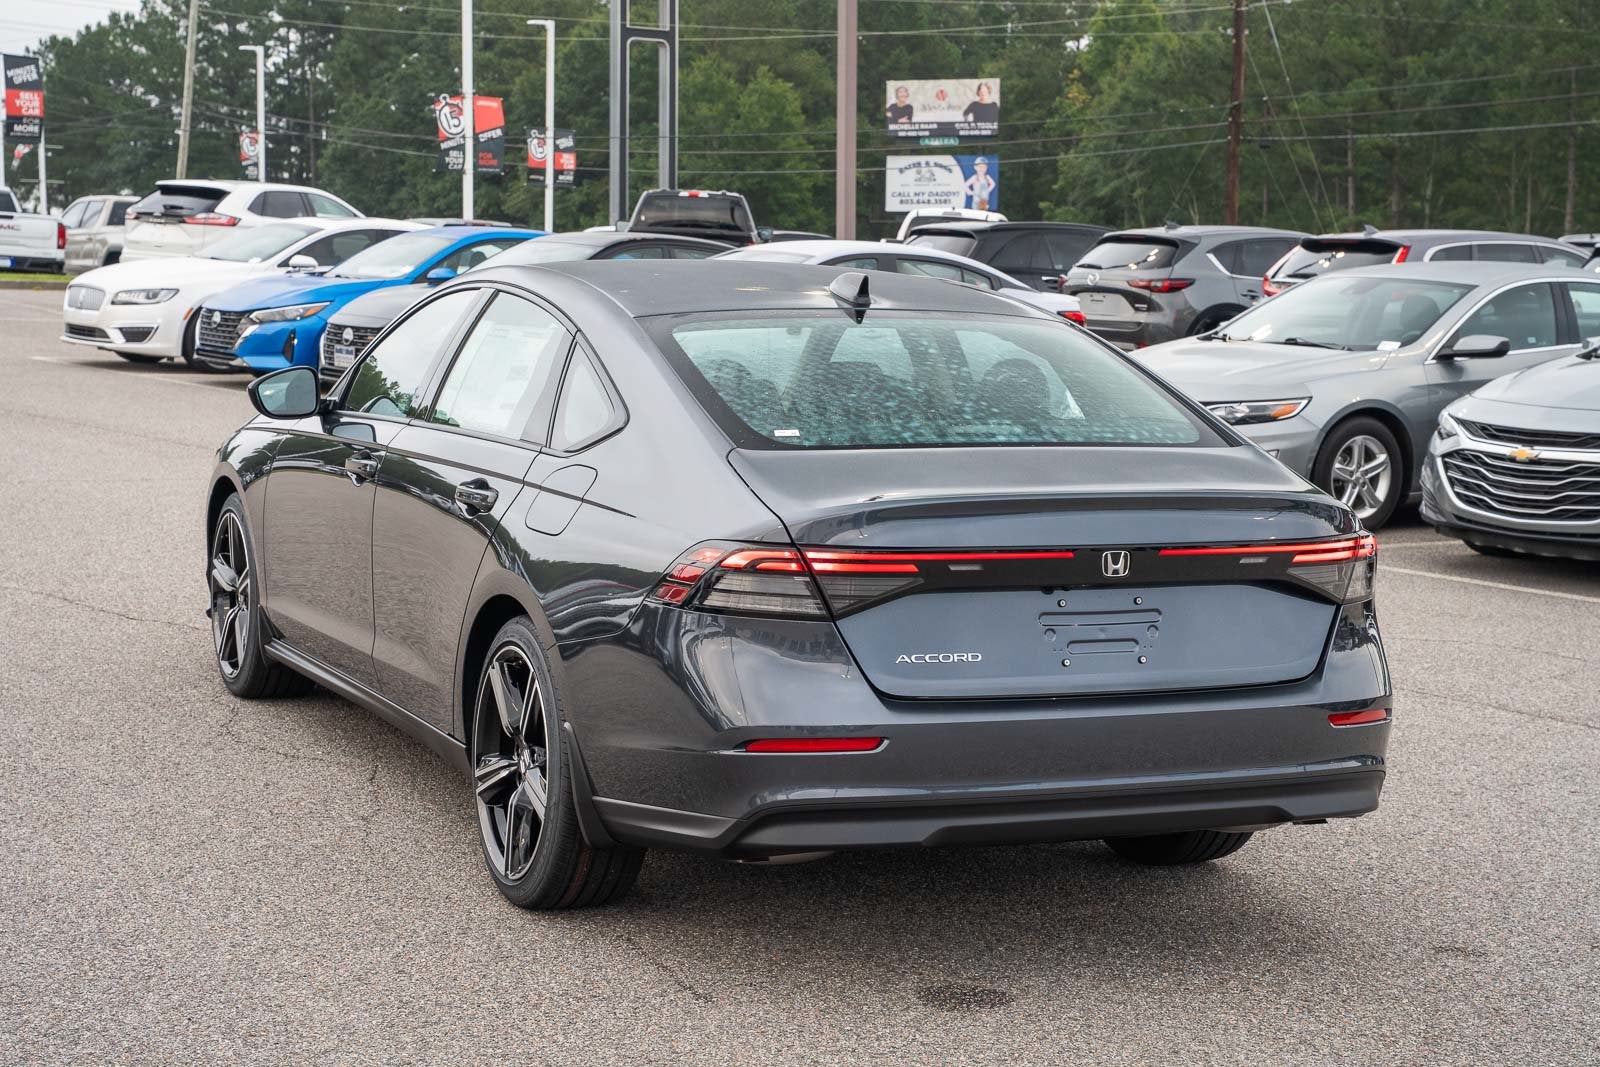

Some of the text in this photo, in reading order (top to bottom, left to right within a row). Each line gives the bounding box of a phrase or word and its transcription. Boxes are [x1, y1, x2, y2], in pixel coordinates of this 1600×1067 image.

[20, 91, 39, 99] SELL
[15, 99, 40, 107] YOUR
[22, 107, 40, 116] CAR
[14, 124, 40, 132] MORE
[895, 652, 982, 664] ACCORD
